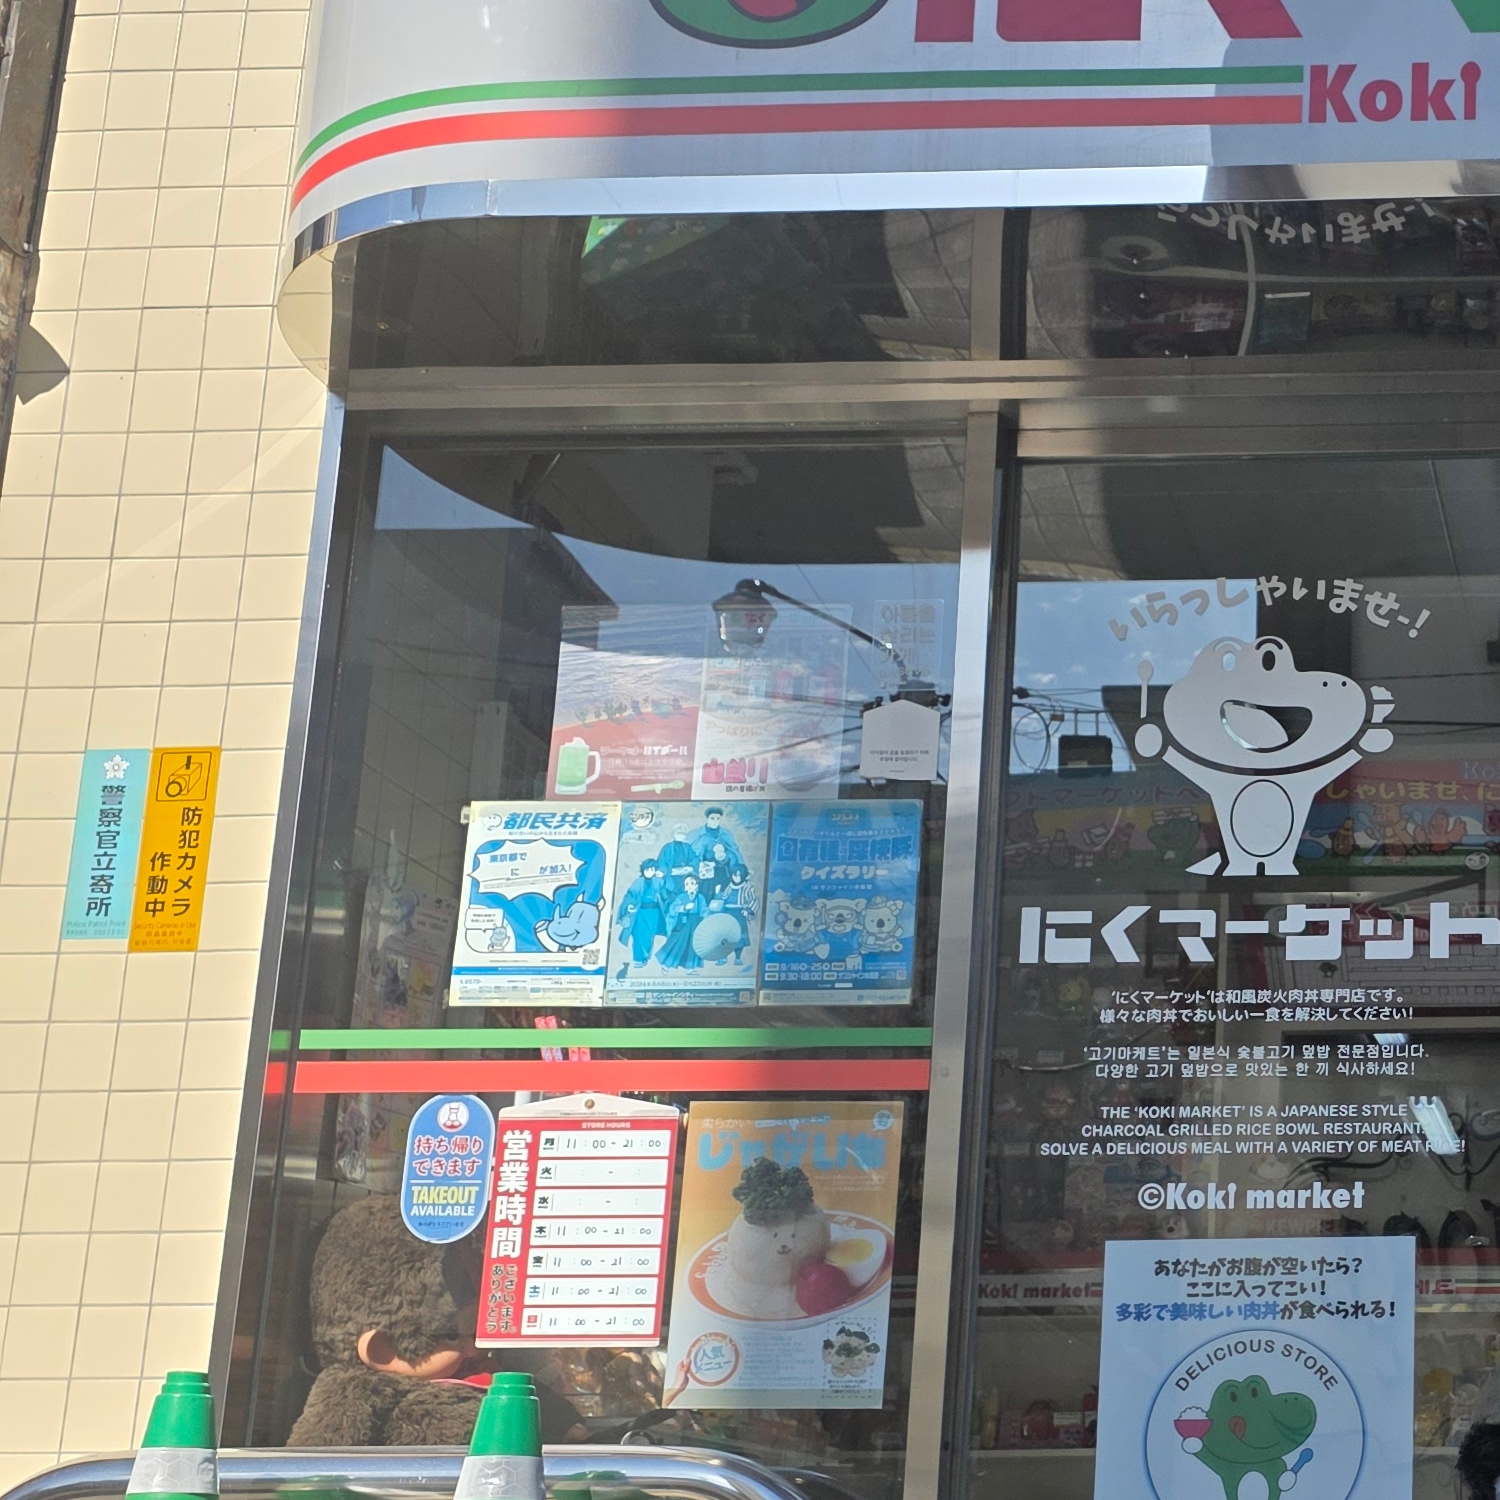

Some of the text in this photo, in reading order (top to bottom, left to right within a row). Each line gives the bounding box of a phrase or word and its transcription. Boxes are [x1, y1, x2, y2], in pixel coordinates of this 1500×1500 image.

[1307, 60, 1483, 124] Koki
[503, 812, 609, 830] 都民共済
[86, 785, 127, 917] 警察官立寄所
[489, 852, 528, 863] 東京都で
[171, 806, 203, 917] 防犯カメラ
[539, 864, 572, 875] が加入!
[800, 865, 889, 881] クイズラリー
[144, 851, 172, 918] 作動中
[88, 920, 108, 928] Patrol
[110, 920, 126, 928] Point
[1187, 1045, 1230, 1061] 일본식
[1237, 1045, 1295, 1060] 숯불고기
[1302, 1045, 1331, 1060] 덮밥
[1336, 1044, 1430, 1060] 전문점입니다.
[1095, 1061, 1416, 1079] 다양한 고기 덮밥으로 맛있는 한 끼 식사하세요!
[1101, 1106, 1130, 1119] THE
[1249, 1105, 1264, 1118] IS
[1266, 1105, 1278, 1118] A
[1281, 1104, 1358, 1118] JAPANESE
[1361, 1104, 1408, 1117] STYLE
[1081, 1123, 1165, 1137] CHARCOAL
[1168, 1123, 1233, 1137] GRILLED
[1236, 1122, 1273, 1136] RICE
[1275, 1122, 1321, 1136] BOWL
[414, 1135, 484, 1156] 持ち帰り
[543, 1138, 555, 1147] 月
[1040, 1142, 1089, 1156] SOLVE
[1092, 1142, 1103, 1156] A
[1106, 1142, 1188, 1156] DELICIOUS
[1191, 1141, 1232, 1155] MEAL
[1235, 1141, 1274, 1154] WITH
[1277, 1140, 1289, 1154] A
[1292, 1140, 1355, 1154] VARIETY
[1357, 1139, 1378, 1153] OF
[1381, 1139, 1421, 1153] MEAT
[413, 1158, 482, 1177] できます
[540, 1166, 552, 1176] 火
[411, 1186, 480, 1205] TAKEOUT
[490, 1130, 533, 1259] 営業時間
[1246, 1181, 1365, 1209] market
[410, 1205, 476, 1217] AVAILABLE
[1154, 1256, 1363, 1277] あなたがお腹が空いたら?
[978, 1282, 1091, 1300] Koki market
[1186, 1279, 1327, 1298] ここに入ってこい!
[485, 1265, 504, 1333] ありがとう
[1115, 1299, 1397, 1323] 多彩で美味しい肉丼が食べられる!
[700, 1344, 726, 1361] 人気
[1174, 1338, 1339, 1393] DELICIOUS STORE
